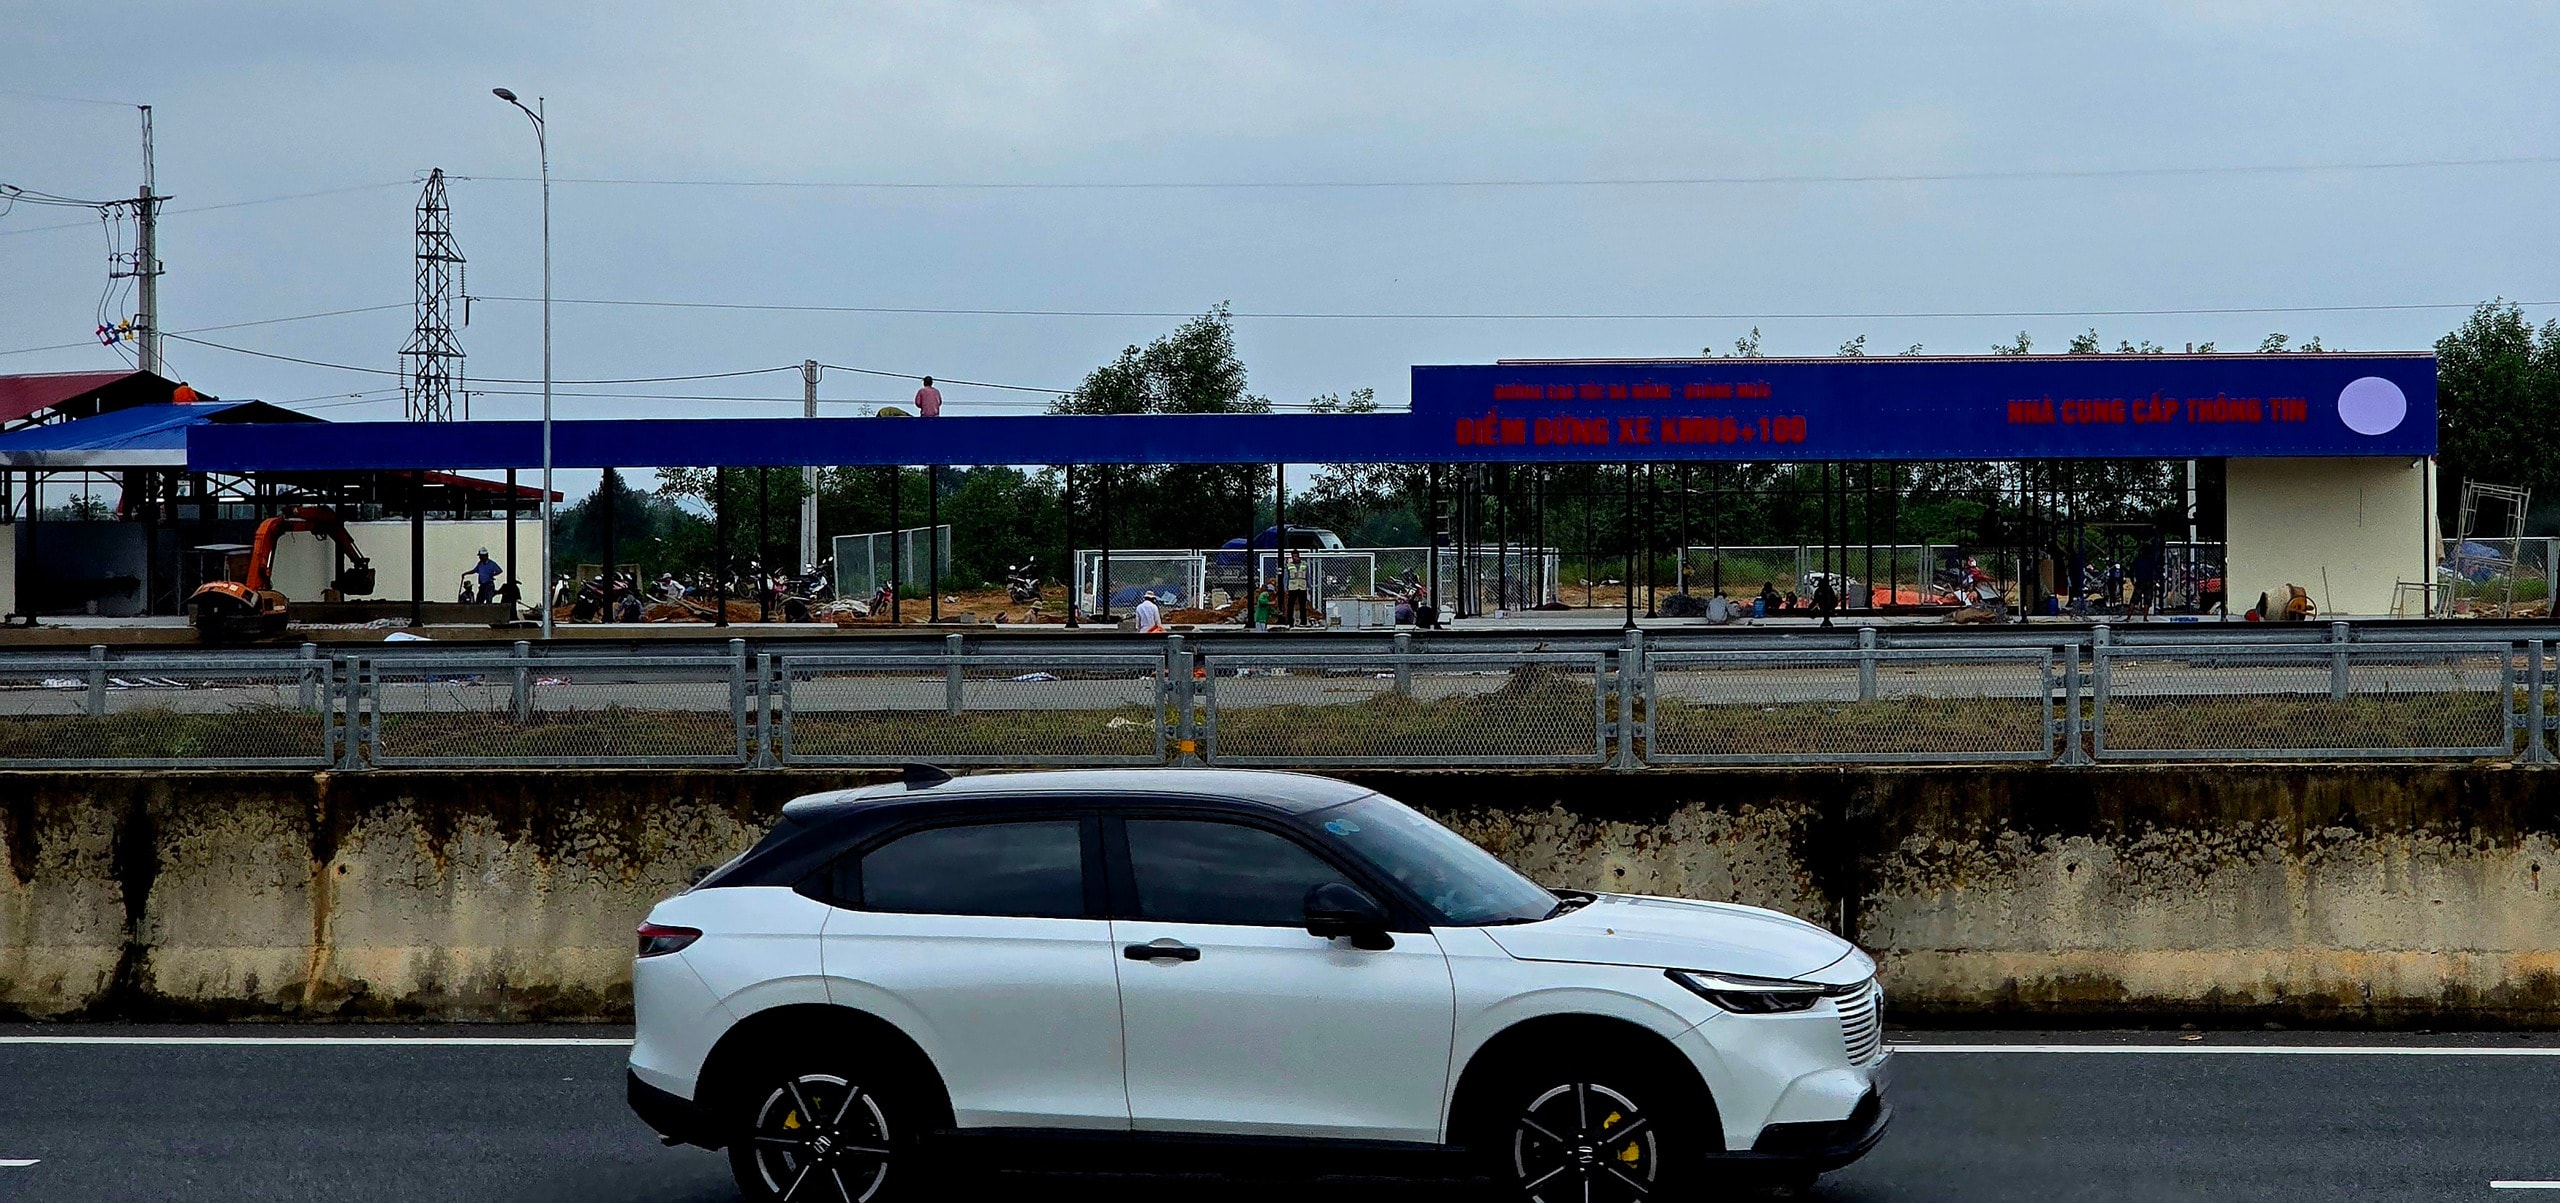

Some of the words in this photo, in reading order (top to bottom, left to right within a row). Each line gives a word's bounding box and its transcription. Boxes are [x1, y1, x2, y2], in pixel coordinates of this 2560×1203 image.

[1547, 384, 1575, 401] CAO
[2008, 394, 2055, 424] NHÀ
[2061, 399, 2126, 425] CUNG
[2132, 389, 2179, 424] CẤP
[2187, 392, 2262, 423] THÔNG
[2269, 397, 2308, 422] TIN
[1534, 412, 1610, 446] DỪNG
[1617, 415, 1652, 445] XE
[1660, 414, 1808, 445] KM96+100
